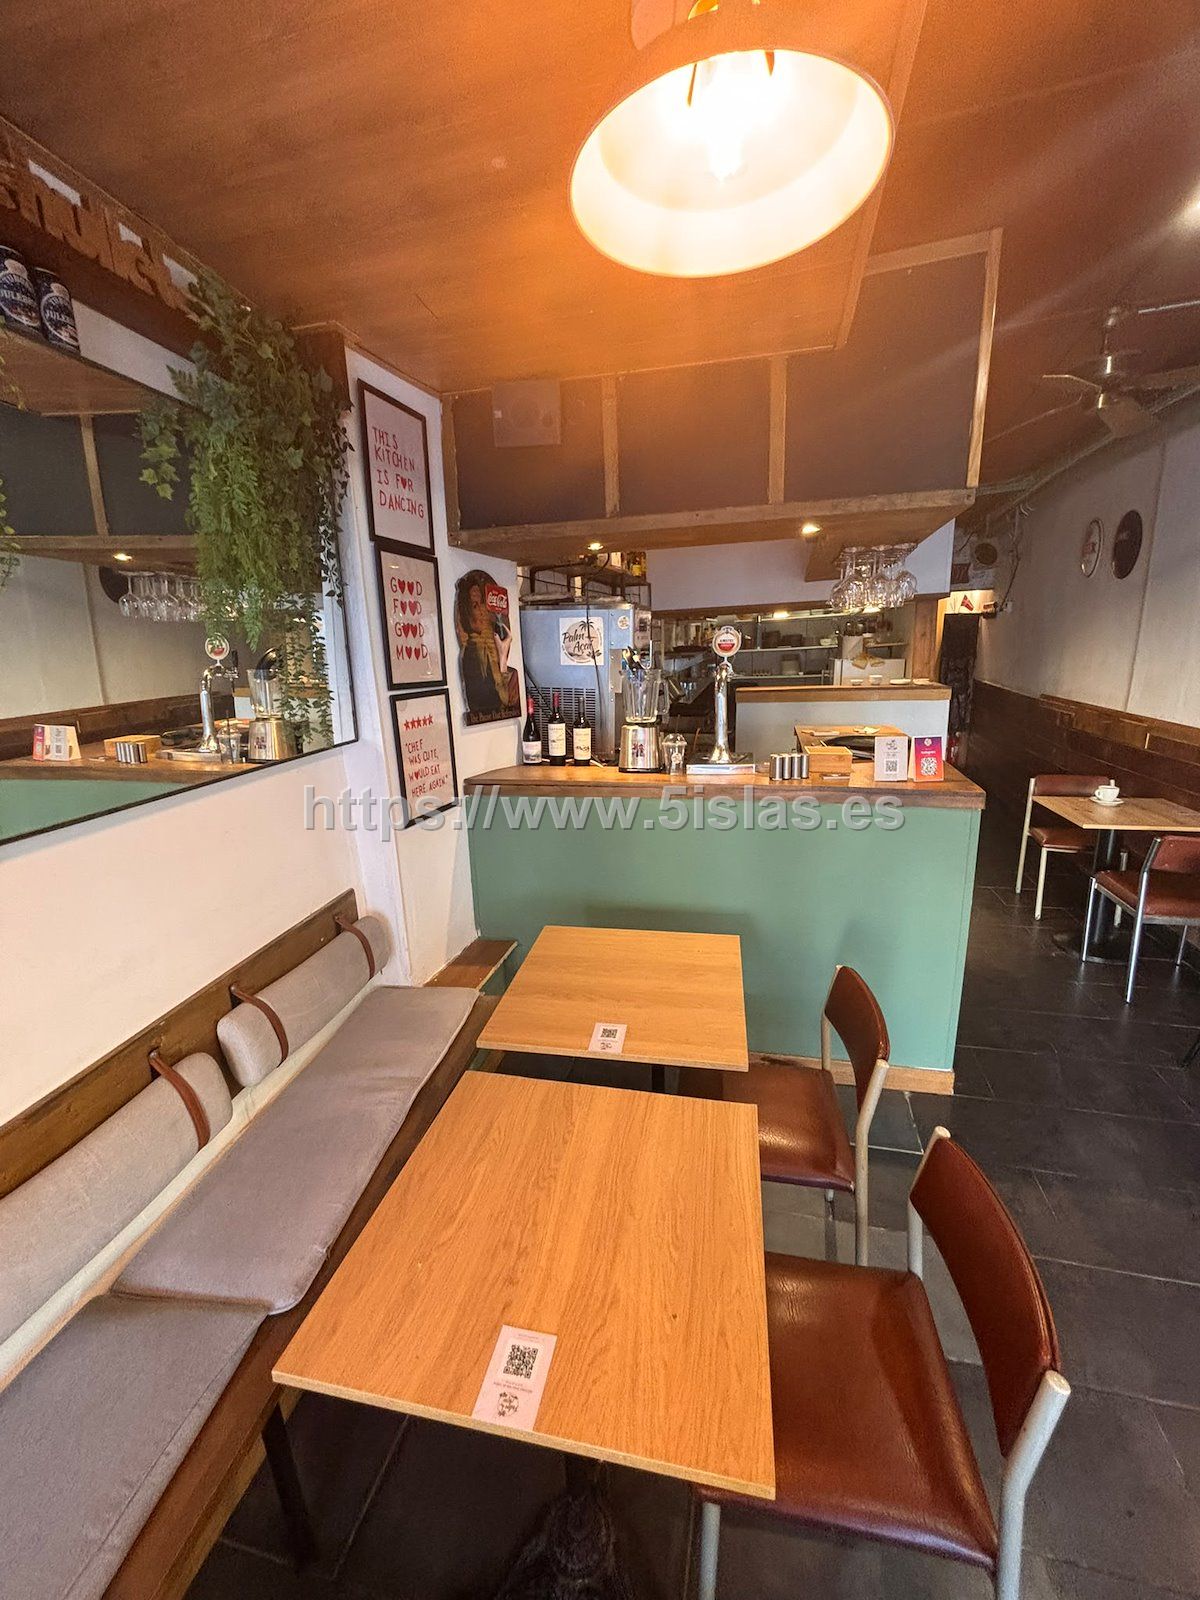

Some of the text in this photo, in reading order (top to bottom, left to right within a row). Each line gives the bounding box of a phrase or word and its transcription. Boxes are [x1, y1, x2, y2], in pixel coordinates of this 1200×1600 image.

[372, 426, 399, 449] THIS
[374, 444, 415, 472] KITCHEN
[377, 469, 390, 485] IS
[379, 490, 424, 519] DANCING
[562, 629, 585, 644] Palm
[408, 754, 421, 766] WAS
[430, 764, 441, 776] EAT
[411, 783, 427, 798] HERE
